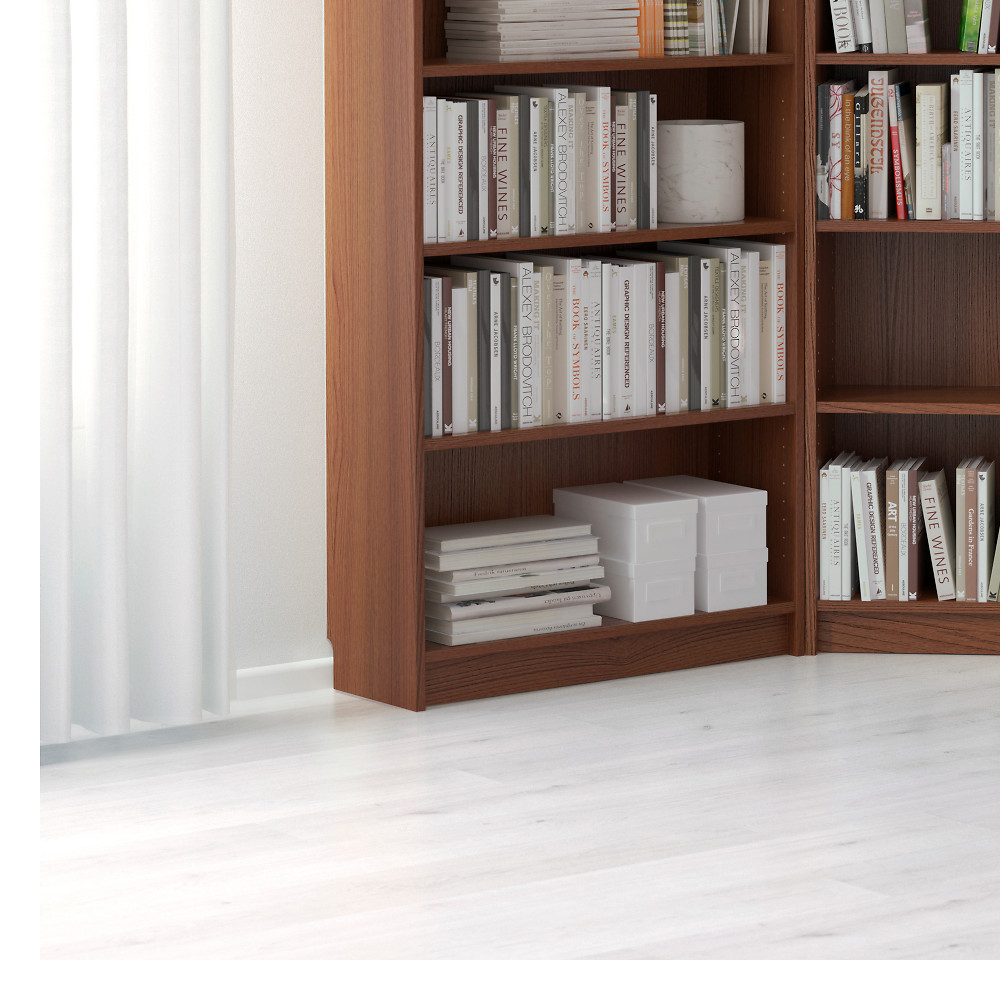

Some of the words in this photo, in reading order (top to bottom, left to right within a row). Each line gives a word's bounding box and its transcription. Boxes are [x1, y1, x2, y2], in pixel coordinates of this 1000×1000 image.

[833, 6, 852, 51] BOOK
[558, 93, 567, 141] ALEXEY
[844, 109, 852, 120] the
[845, 99, 852, 107] In
[989, 119, 996, 129] IT
[498, 128, 507, 161] FINE
[602, 122, 610, 150] BOOK
[617, 123, 626, 157] FINE
[844, 123, 852, 143] blink
[844, 144, 852, 153] of
[963, 107, 972, 181] ANTIQUAIRES
[429, 134, 437, 206] ANTIQUAIRES
[842, 166, 850, 182] eye
[844, 155, 850, 164] an
[892, 149, 903, 206] SYMBOLISMUS
[498, 169, 507, 221] WINES
[558, 145, 567, 226] BRODOVITCH
[602, 161, 610, 213] SYMBOLS
[617, 164, 626, 214] WINES
[522, 268, 533, 322] ALEXEY
[730, 252, 740, 304] ALEXEY
[776, 282, 784, 314] BOOK
[534, 320, 540, 331] IT
[572, 298, 581, 331] BOOK
[741, 304, 747, 314] IT
[593, 302, 601, 380] ANTIQUAIRES
[730, 309, 740, 397] BRODOVITCH
[776, 326, 785, 381] SYMBOLS
[522, 326, 533, 418] BRODOVITCH
[572, 343, 581, 401] SYMBOLS
[888, 501, 898, 522] ART
[925, 496, 940, 531] FINE
[872, 534, 880, 576] REFERENCED
[932, 535, 950, 585] WINES
